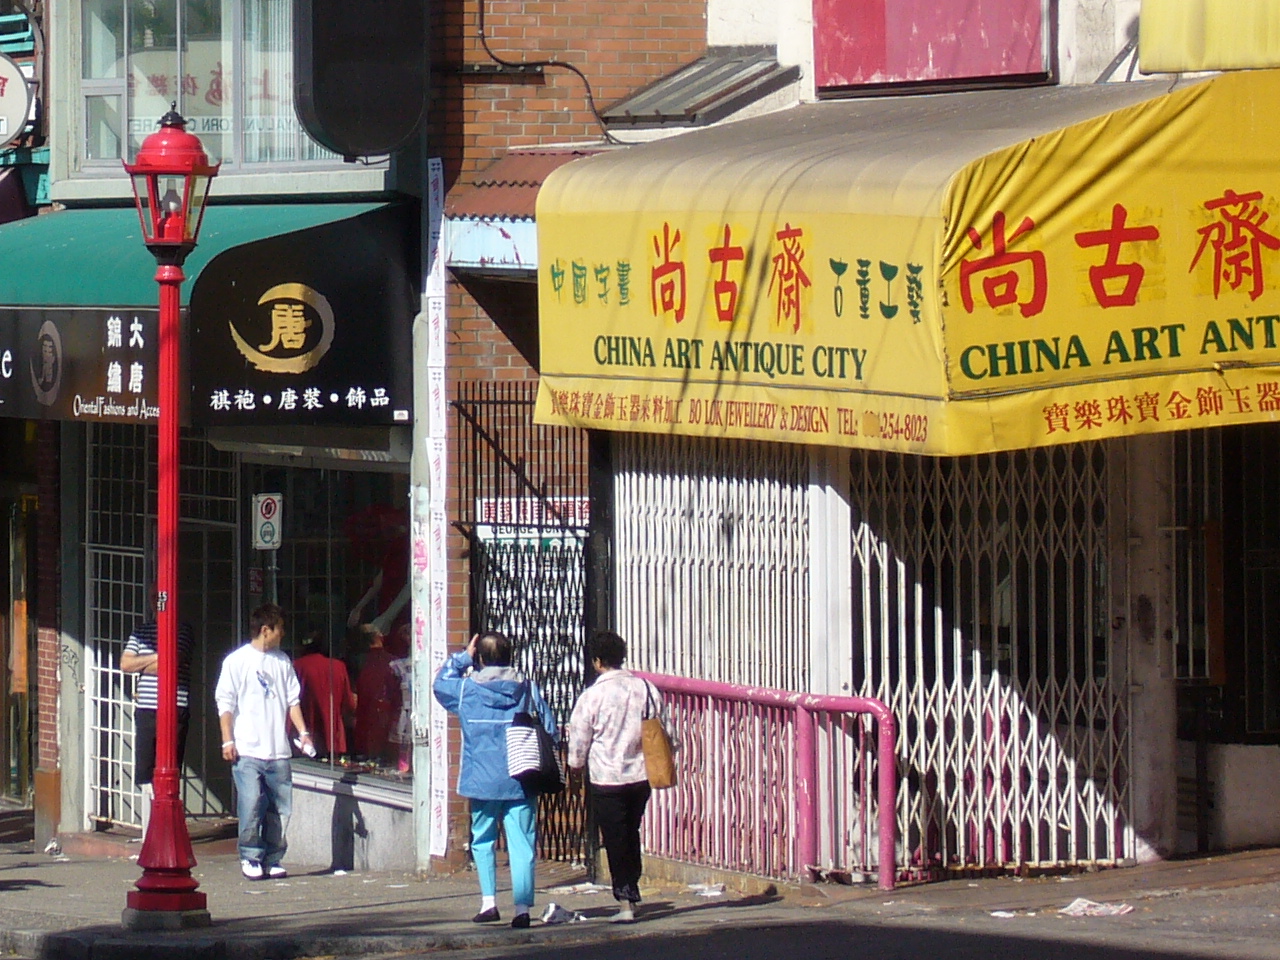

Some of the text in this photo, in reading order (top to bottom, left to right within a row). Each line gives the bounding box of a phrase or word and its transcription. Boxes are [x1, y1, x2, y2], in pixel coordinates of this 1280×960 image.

[650, 222, 812, 335] 尚古齋
[593, 334, 868, 381] CHINA ART ANTIQUE CITY
[960, 334, 1091, 380] CHINA
[1102, 323, 1186, 364] ART
[73, 395, 98, 417] Oriental
[98, 397, 125, 418] Fashions
[127, 398, 139, 416] and
[689, 400, 703, 424] BO
[704, 401, 722, 425] LOK
[723, 401, 778, 431] JEWELLERY
[780, 412, 789, 430] &
[790, 407, 829, 434] DESIGN
[837, 407, 858, 436] TEL:
